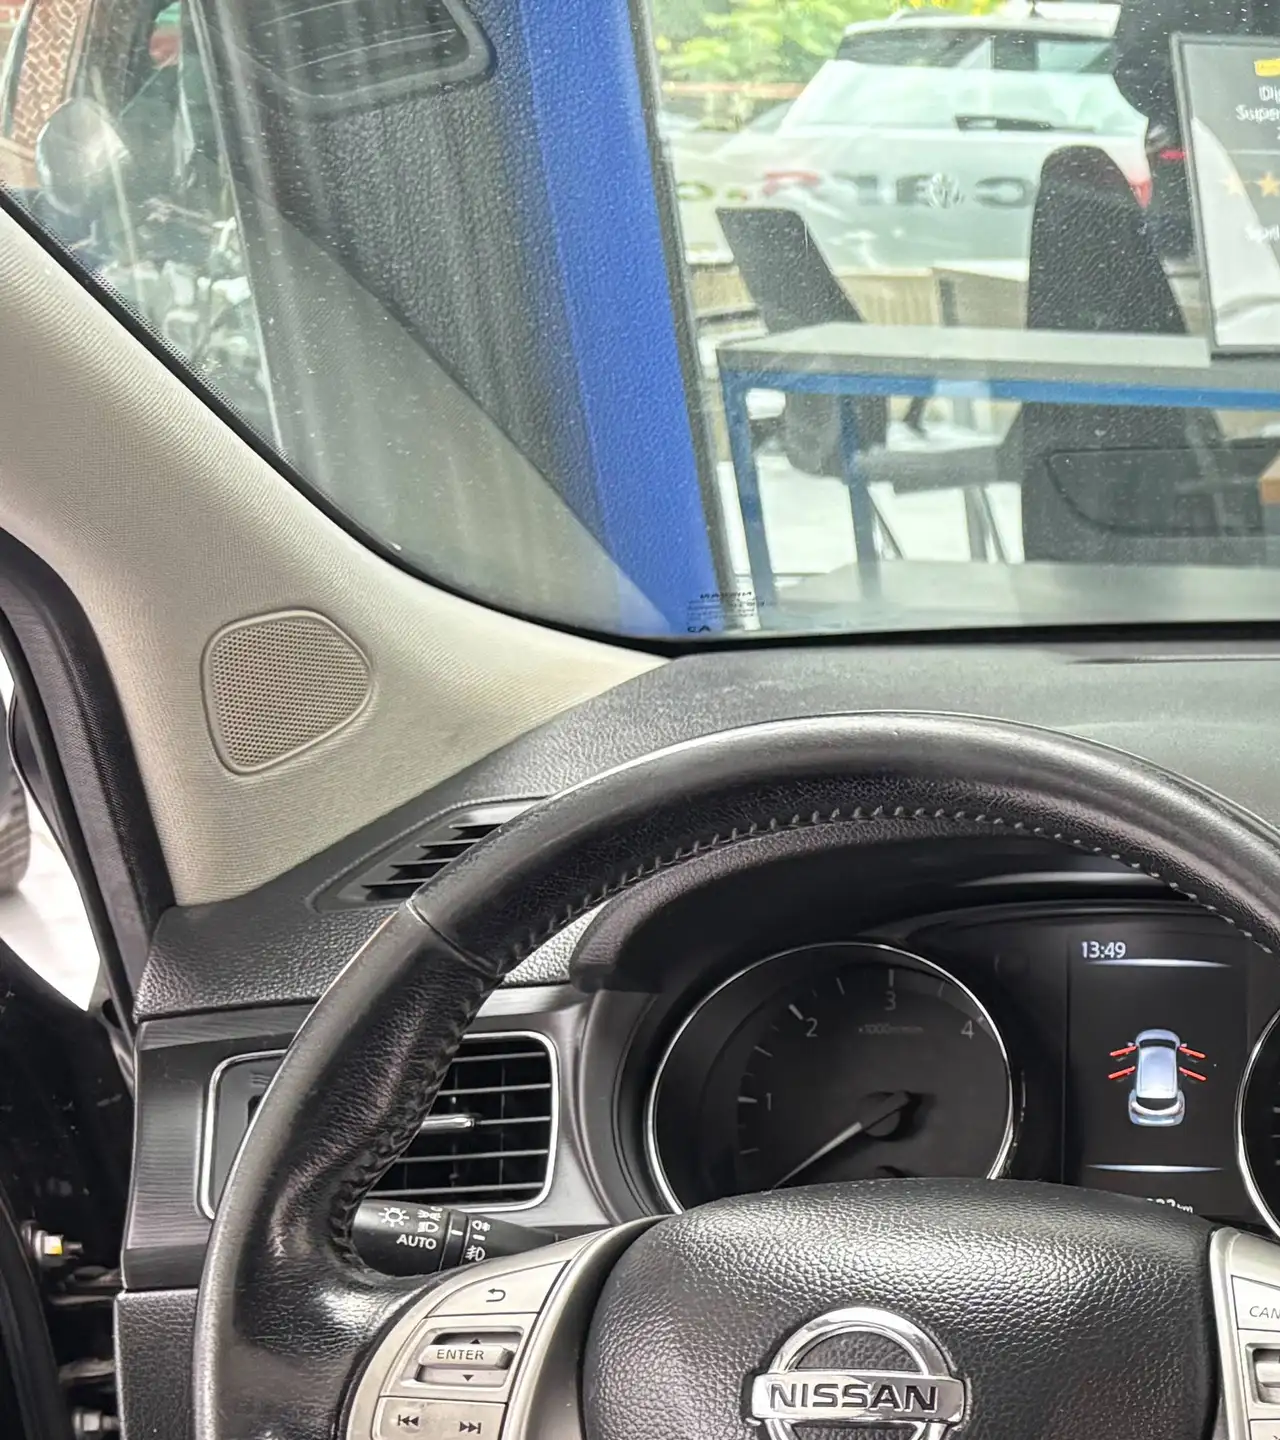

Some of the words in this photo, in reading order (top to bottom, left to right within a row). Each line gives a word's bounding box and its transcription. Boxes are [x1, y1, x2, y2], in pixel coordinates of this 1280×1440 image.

[1081, 941, 1126, 959] 13:49
[884, 991, 897, 1011] 3
[805, 1017, 818, 1037] 2
[960, 1019, 975, 1039] 4
[765, 1092, 772, 1111] 1
[396, 1233, 437, 1250] AUTO
[436, 1349, 485, 1361] ENTER
[769, 1383, 938, 1411] NISSAN
